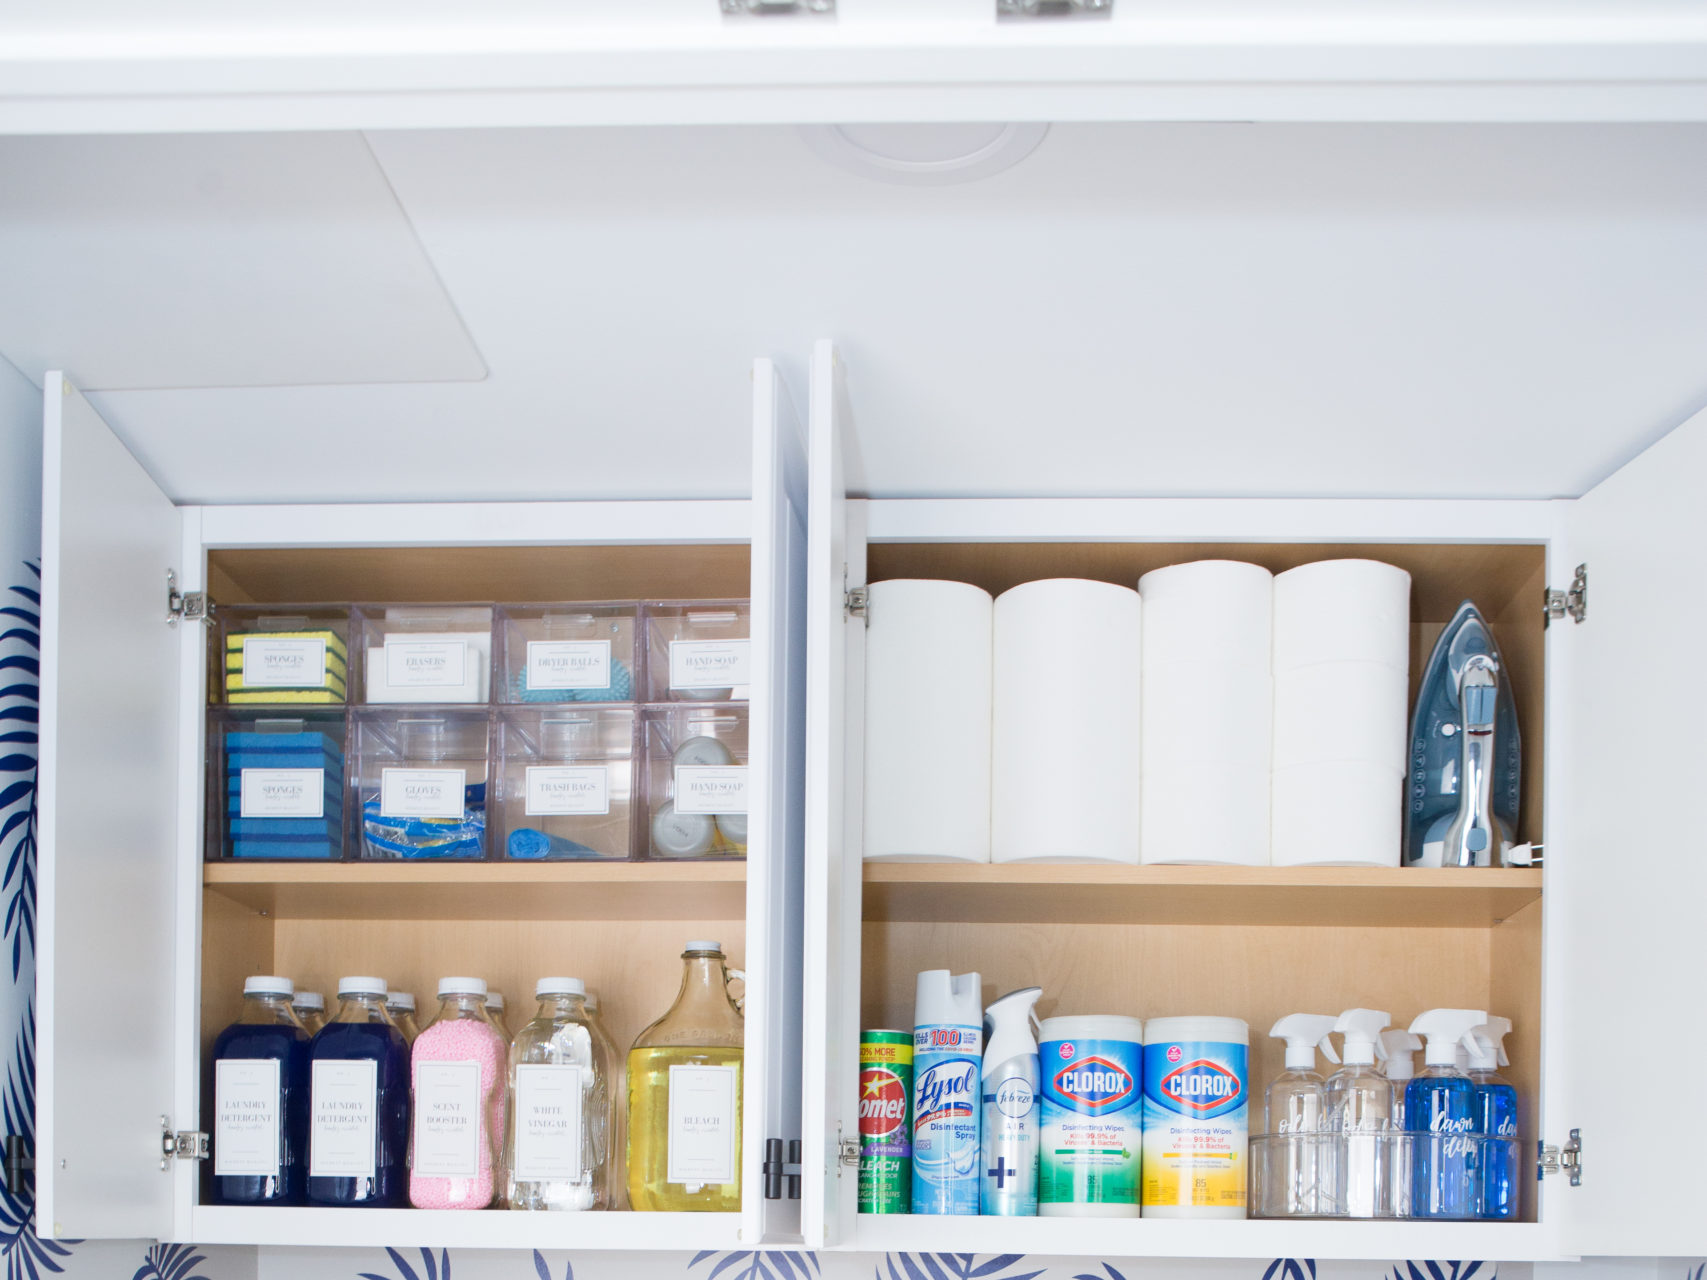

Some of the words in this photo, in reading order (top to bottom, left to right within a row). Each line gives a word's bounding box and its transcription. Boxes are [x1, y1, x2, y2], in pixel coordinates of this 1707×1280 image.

[930, 1029, 961, 1046] 100
[874, 1047, 896, 1057] MORE
[1062, 1071, 1125, 1094] CLOROX
[1170, 1074, 1233, 1097] CLOROX
[916, 1065, 974, 1111] Lysol
[859, 1098, 905, 1118] omet
[683, 1116, 720, 1125] BLEACH
[1430, 1111, 1474, 1132] dawn
[930, 1122, 976, 1131] Disinfectant
[1105, 1124, 1125, 1132] Wipes
[1213, 1127, 1232, 1135] Wipes
[955, 1131, 976, 1141] Spray
[1195, 1178, 1207, 1188] 85
